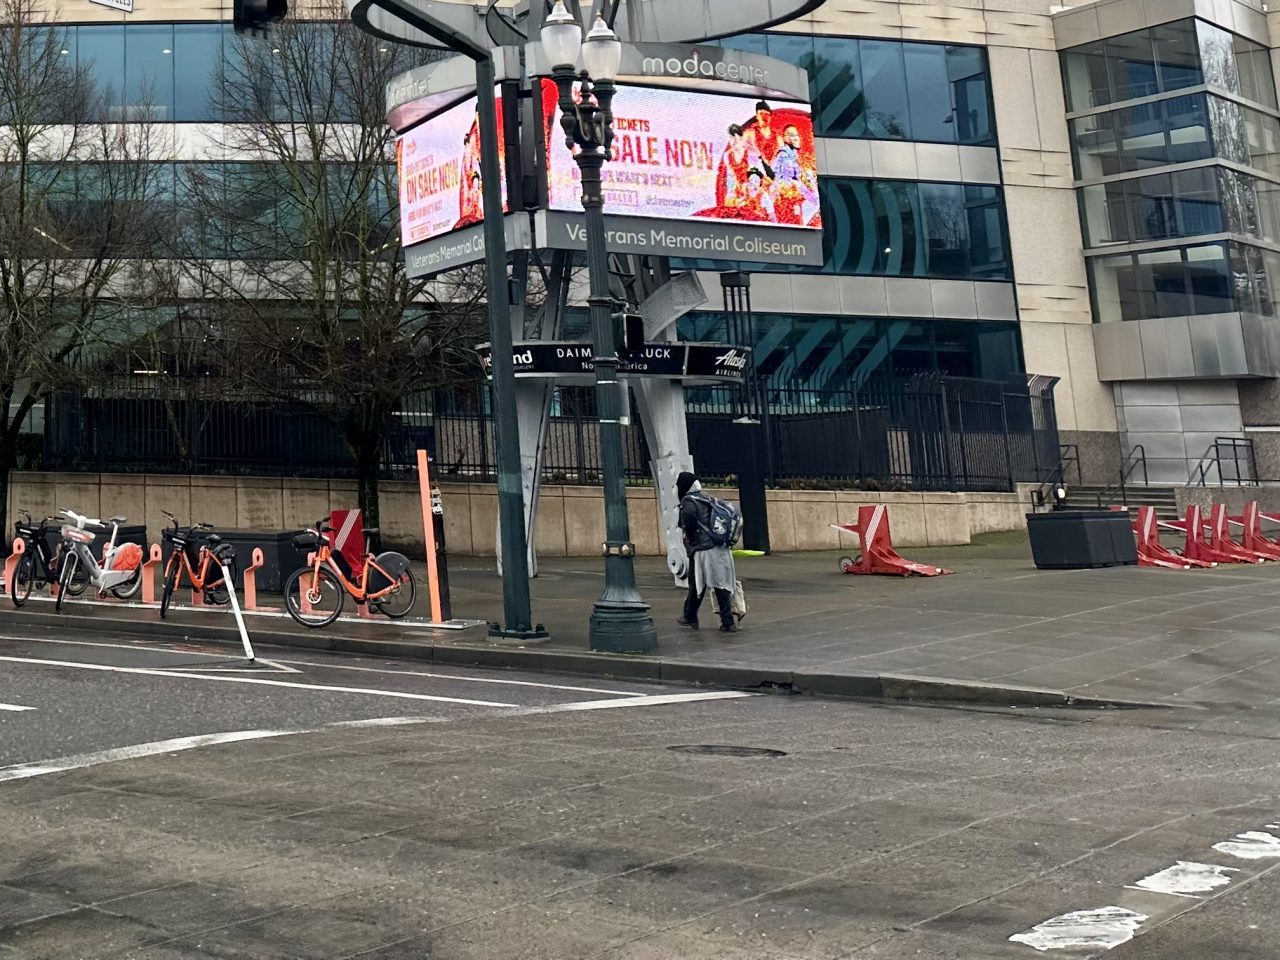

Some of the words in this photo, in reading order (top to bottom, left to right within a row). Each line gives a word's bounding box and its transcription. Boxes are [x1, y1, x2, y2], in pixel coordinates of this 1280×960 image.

[642, 53, 769, 83] modacenter
[610, 134, 659, 166] SALE
[665, 138, 714, 171] NOW
[407, 175, 417, 205] ON
[419, 167, 437, 200] SALE
[439, 157, 458, 192] NOW
[411, 250, 440, 269] Veterans
[440, 238, 472, 262] Memorial
[565, 223, 647, 246] Verans
[650, 229, 729, 252] Memorial
[732, 235, 807, 257] Coliseum
